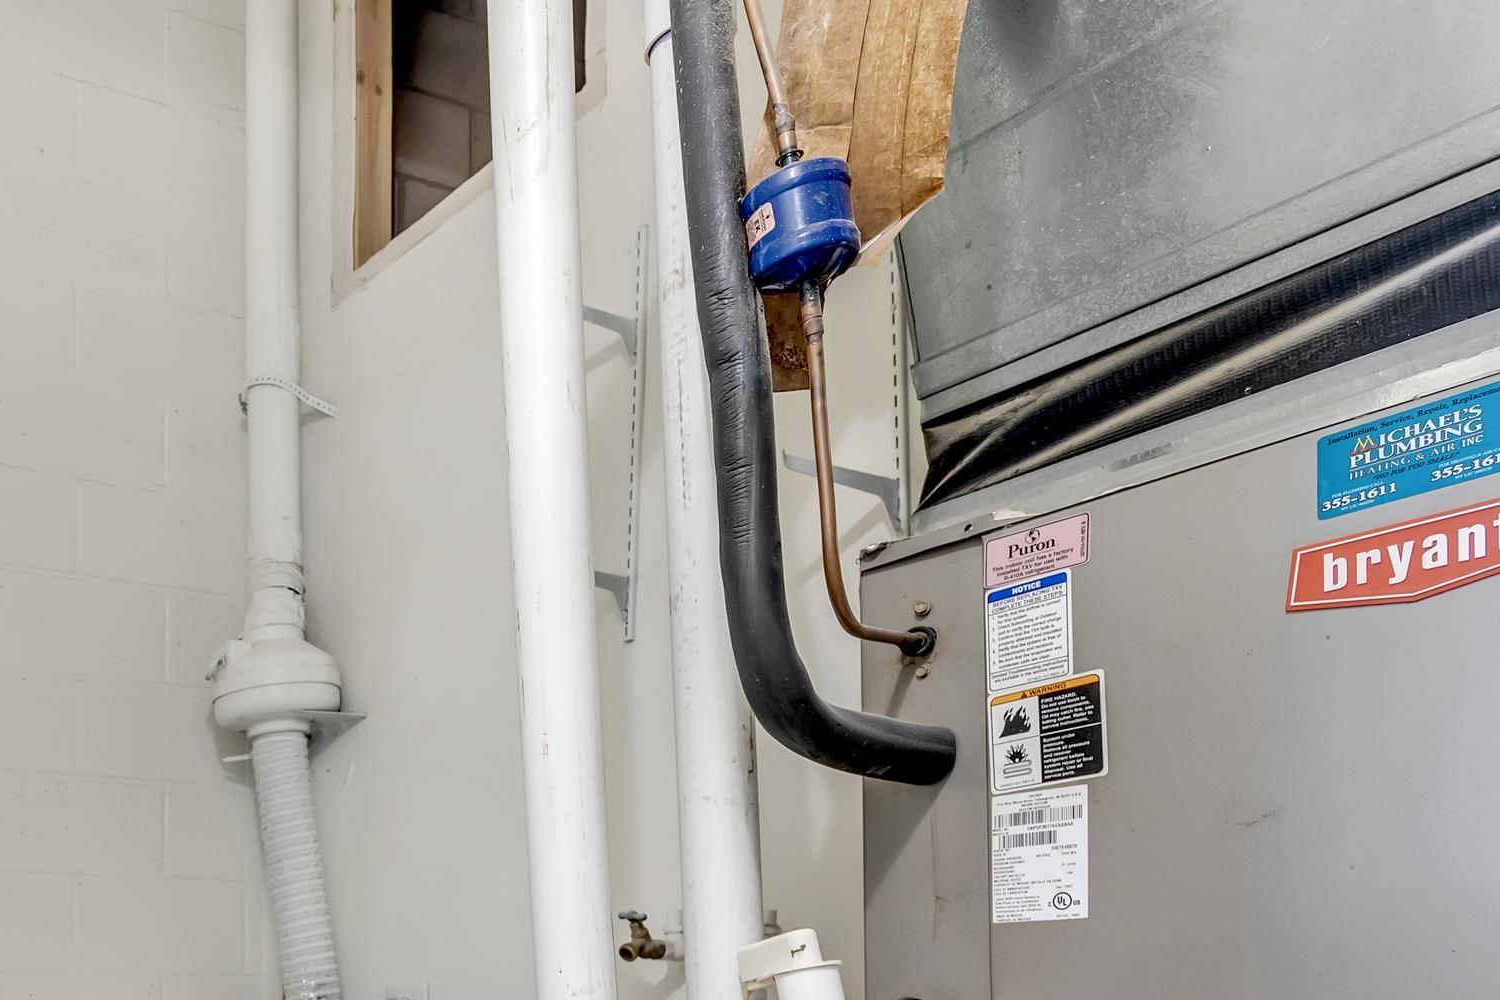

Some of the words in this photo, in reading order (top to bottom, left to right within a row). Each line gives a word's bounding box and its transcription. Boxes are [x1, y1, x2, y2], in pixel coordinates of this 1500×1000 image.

[1349, 417, 1483, 469] PLUMBING
[1349, 457, 1411, 480] HEATING
[1416, 452, 1425, 461] &
[1461, 434, 1484, 448] INC
[1408, 461, 1426, 471] TOO
[1321, 482, 1397, 512] 355-1611
[1005, 560, 1023, 570] indoor
[1053, 547, 1074, 557] factory
[1008, 538, 1056, 559] Puron
[992, 595, 1018, 608] BEFORE
[1018, 586, 1050, 604] REPLACING
[1011, 580, 1042, 595] NOTICE
[991, 602, 1022, 614] COMPLETE
[1023, 596, 1043, 606] THESE
[1028, 683, 1067, 696] WARNING
[1040, 696, 1053, 704] FIRE
